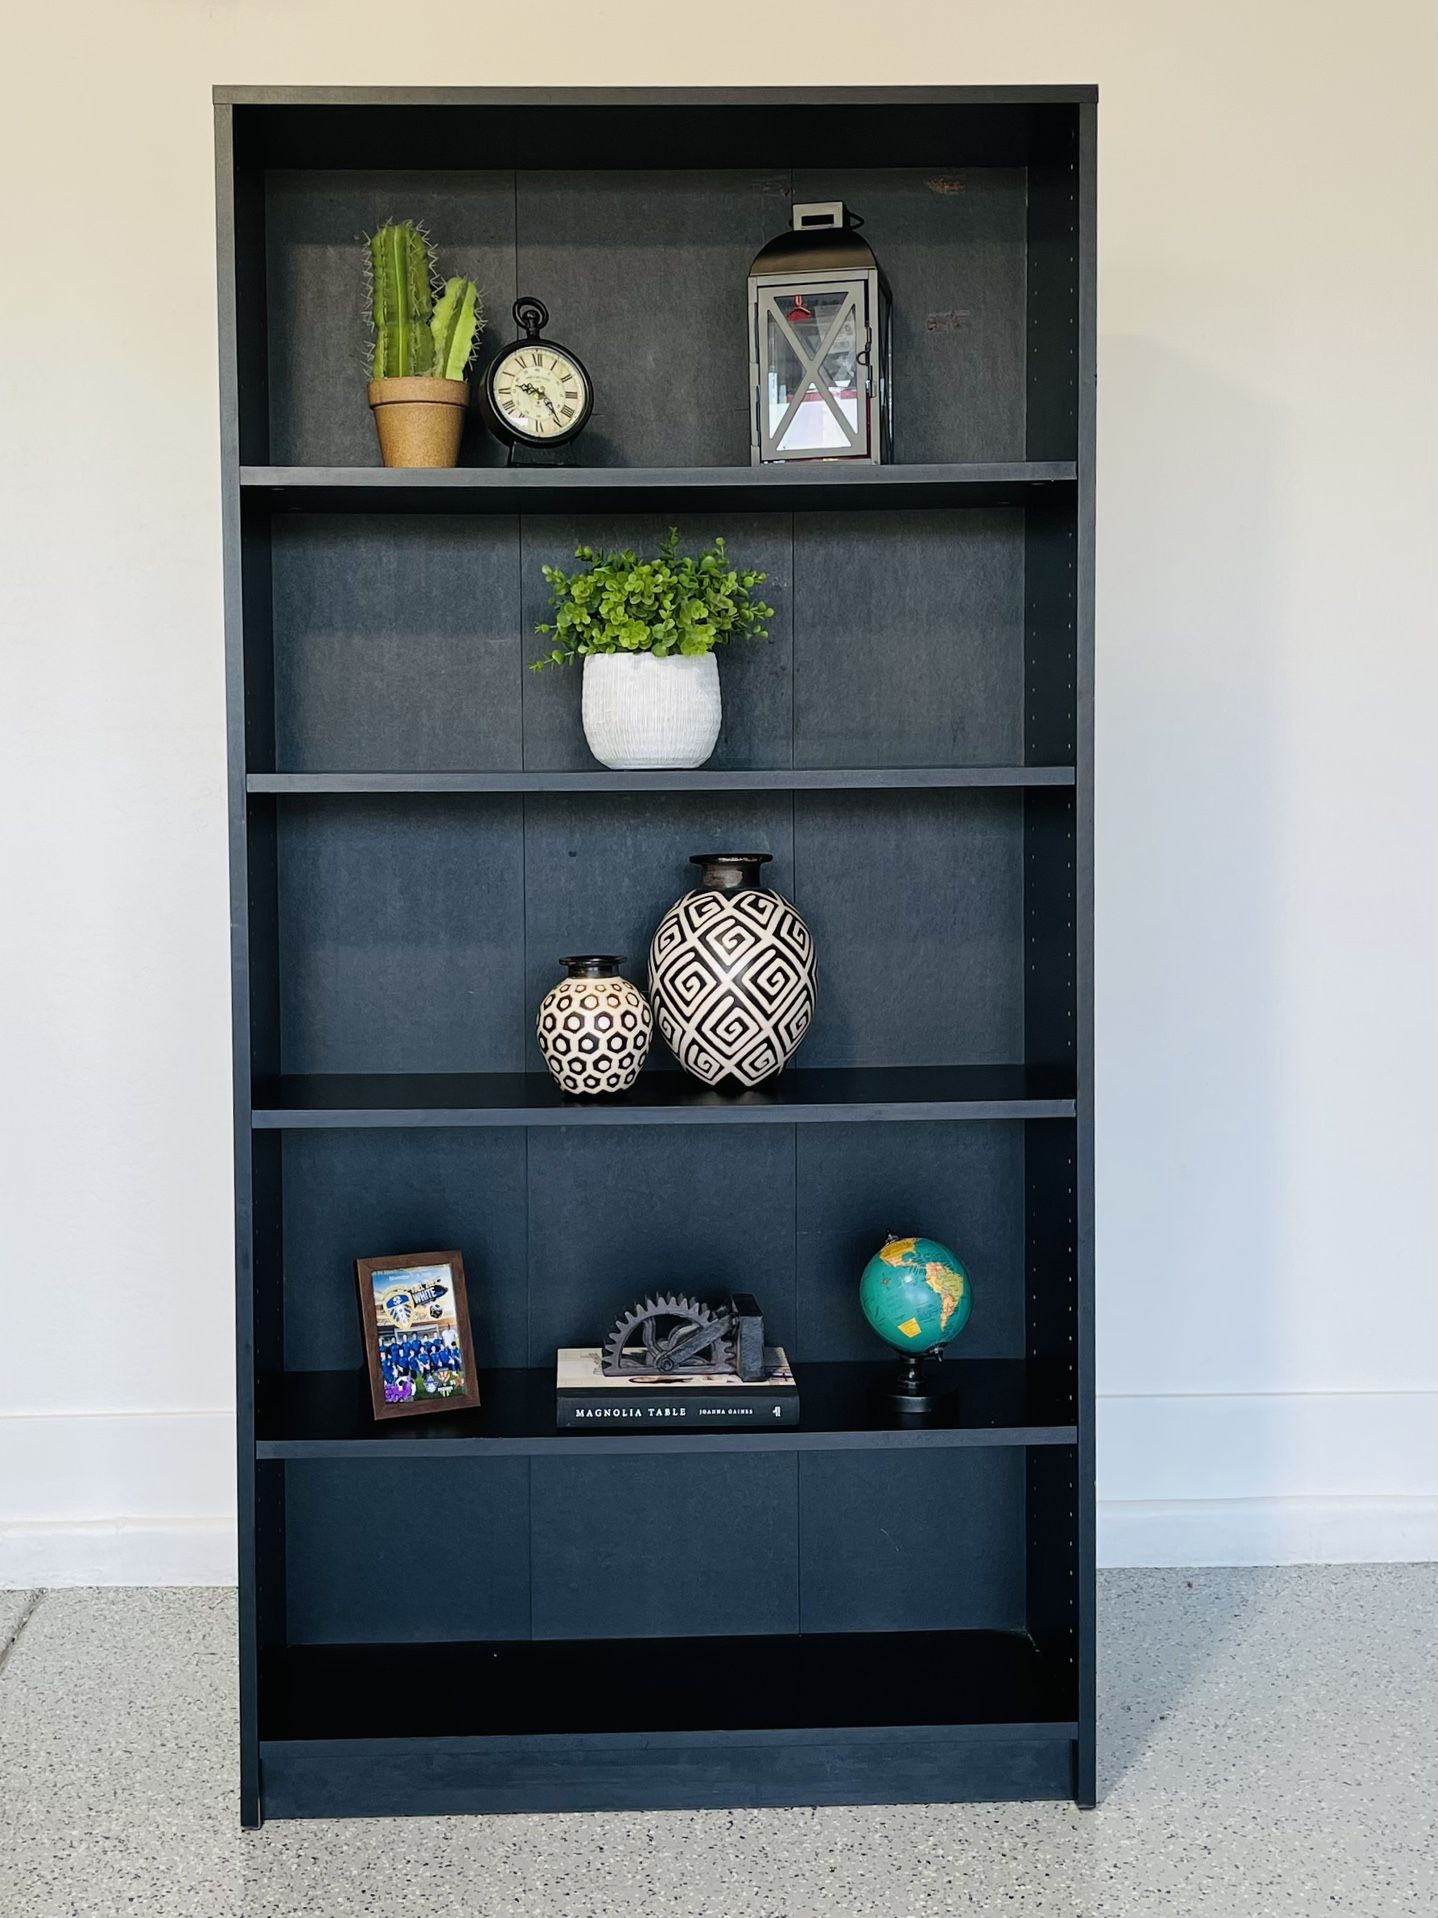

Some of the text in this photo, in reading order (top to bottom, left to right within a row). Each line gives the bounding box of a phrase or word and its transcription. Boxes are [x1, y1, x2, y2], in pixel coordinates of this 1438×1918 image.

[412, 1287, 436, 1304] WHITE
[575, 1407, 686, 1418] MAGNOLIA TABLE
[699, 1408, 726, 1416] JOANNA
